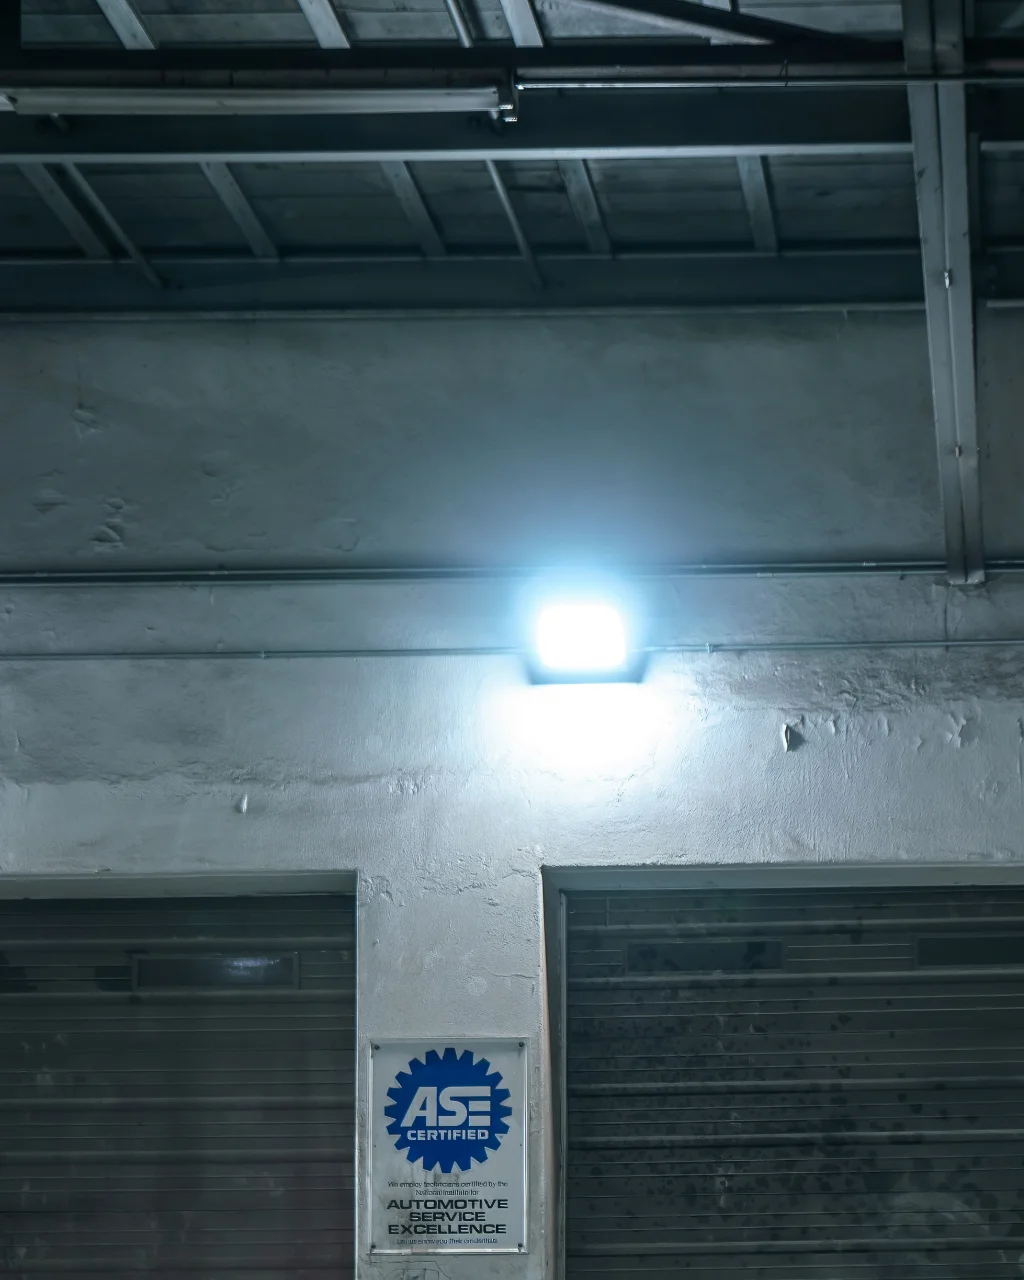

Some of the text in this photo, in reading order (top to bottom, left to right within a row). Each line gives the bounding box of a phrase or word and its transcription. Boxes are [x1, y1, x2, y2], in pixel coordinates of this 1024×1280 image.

[400, 1085, 491, 1128] ASE
[407, 1129, 489, 1141] CERTIFIED
[387, 1199, 509, 1210] AUTOMOTIVE
[409, 1211, 486, 1222] SERVICE
[388, 1224, 507, 1235] EXCELLENCE
